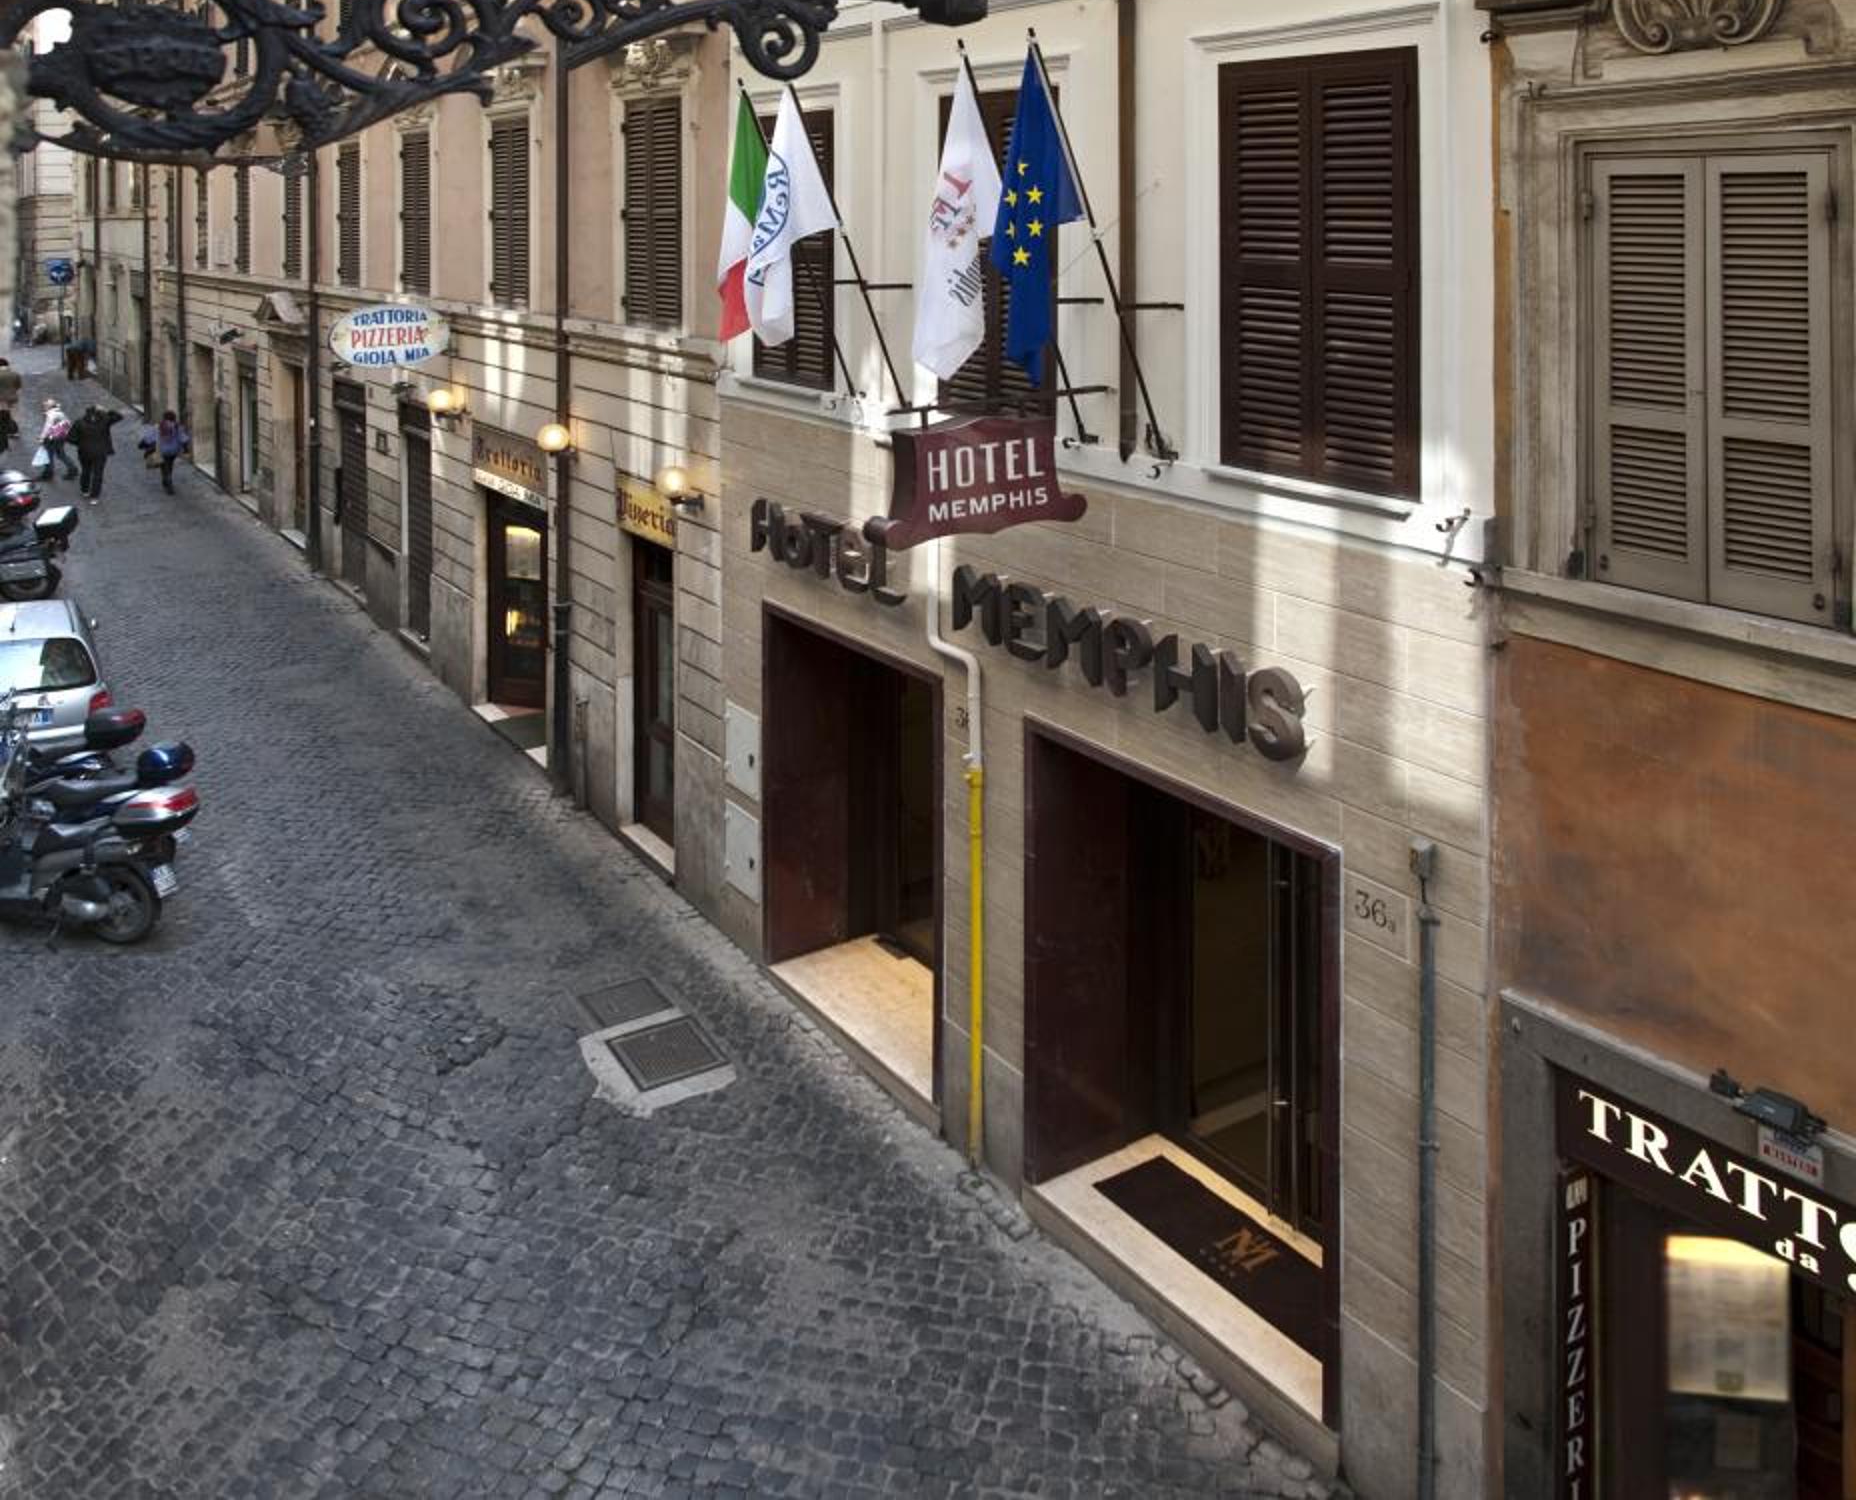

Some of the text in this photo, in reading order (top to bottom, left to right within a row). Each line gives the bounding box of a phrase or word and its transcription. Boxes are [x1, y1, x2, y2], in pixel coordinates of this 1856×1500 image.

[352, 308, 428, 326] TRATTORIA
[351, 324, 426, 349] PIZZERIA
[353, 346, 431, 365] GIOIA MIA
[927, 437, 1046, 493] HOTEL
[928, 486, 1049, 524] MEMPHIS
[751, 496, 1306, 762] HOTEL MEMPHIS
[1774, 1237, 1821, 1274] da
